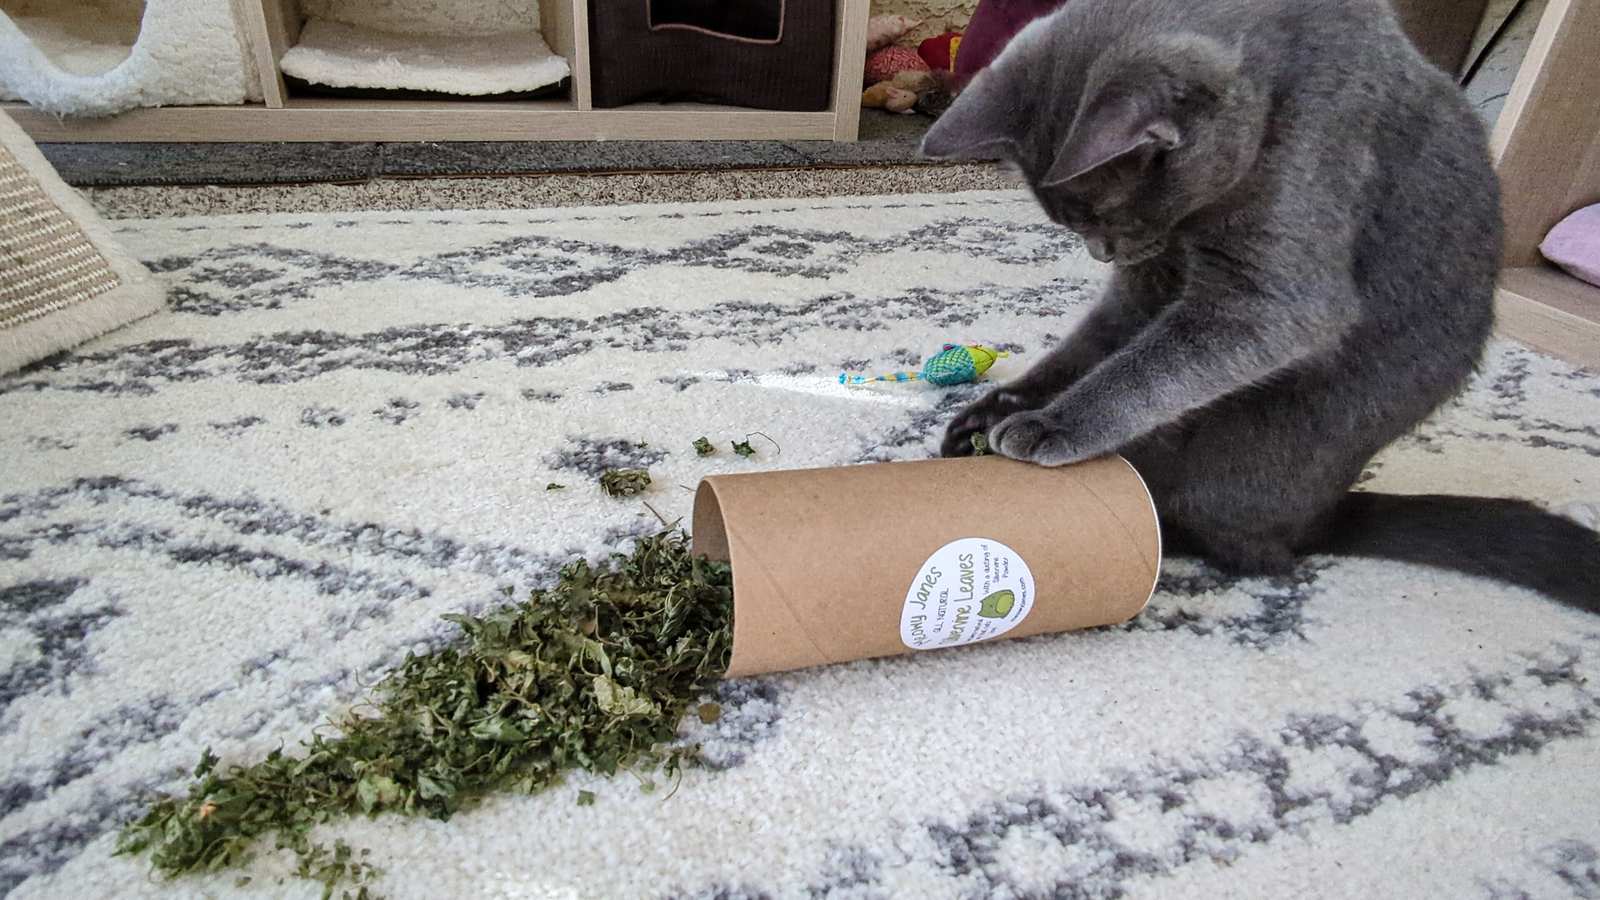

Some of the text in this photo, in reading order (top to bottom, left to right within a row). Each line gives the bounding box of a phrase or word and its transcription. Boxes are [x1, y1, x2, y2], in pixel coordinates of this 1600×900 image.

[909, 566, 942, 610] Janes
[938, 553, 974, 645] ervine Leaves
